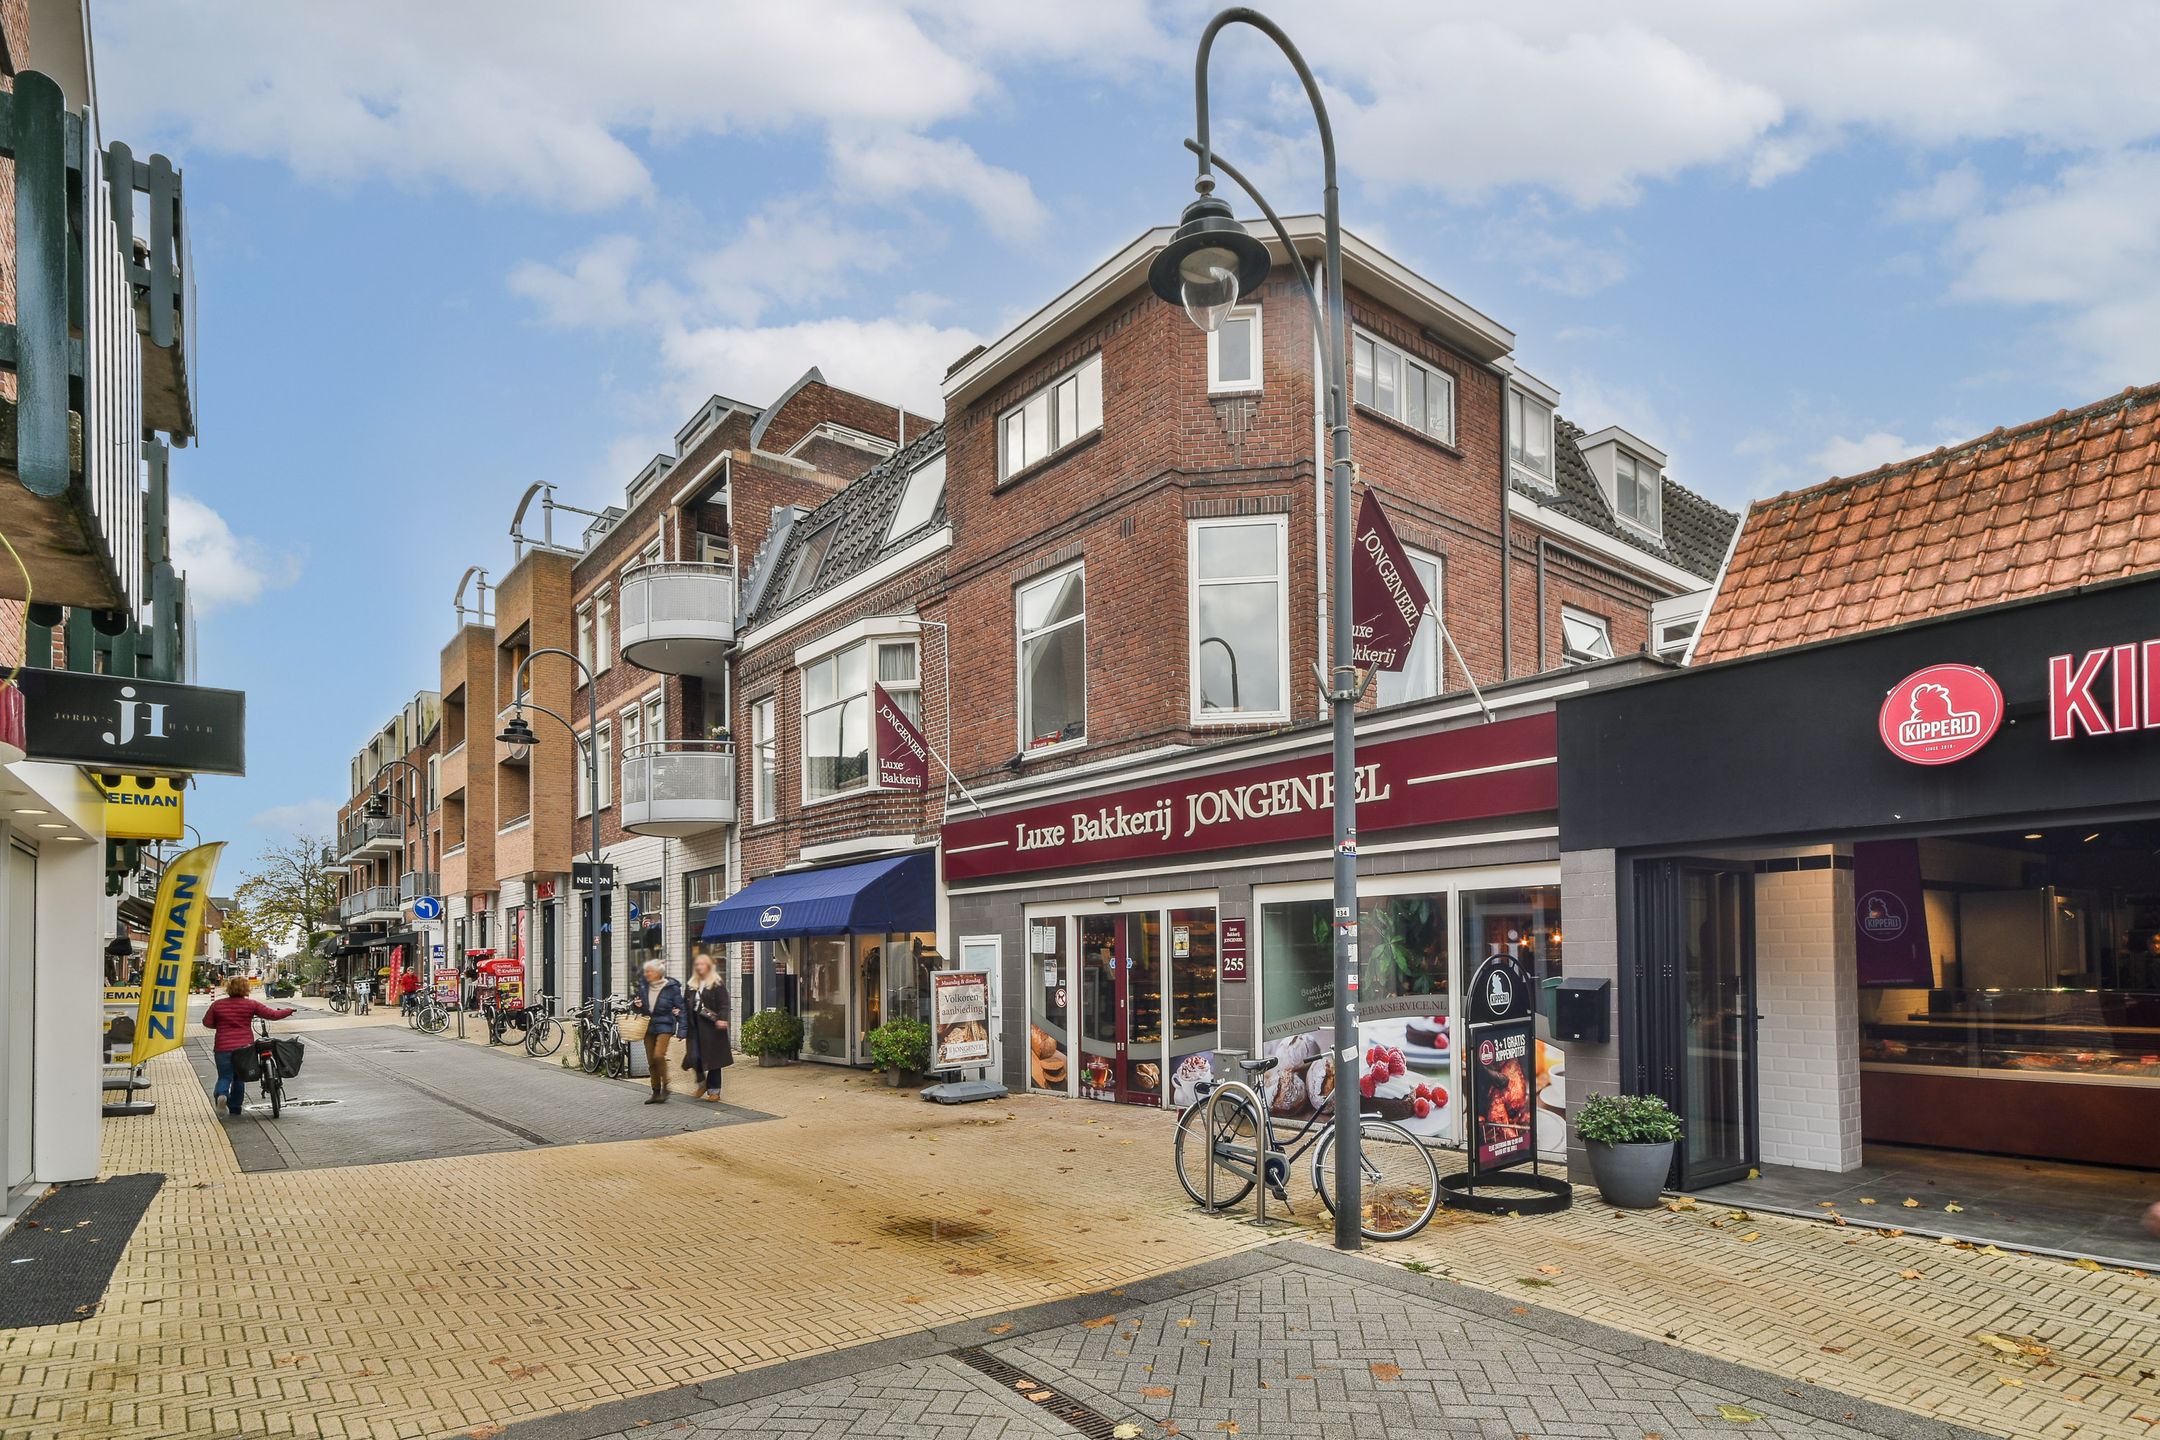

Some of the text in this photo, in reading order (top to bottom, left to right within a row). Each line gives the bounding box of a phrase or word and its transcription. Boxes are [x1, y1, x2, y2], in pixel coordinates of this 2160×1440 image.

[1358, 527, 1420, 627] JONGENEEL
[1352, 624, 1374, 638] uxe
[1352, 644, 1397, 668] kkerij
[53, 712, 213, 734] JORDY'S HAIR
[1905, 716, 1973, 741] KIPPERIJ
[876, 703, 927, 763] JONGENEEL
[880, 758, 904, 770] Luxe
[881, 772, 922, 788] Bakkerij
[108, 792, 178, 807] EEMAN
[1016, 823, 1065, 852] Luxe
[1071, 799, 1172, 844] Bakkerij
[576, 876, 611, 884] NELN
[1867, 918, 1898, 928] KIPPERIJ
[148, 874, 199, 1040] ZEEMAN
[1223, 957, 1244, 971] 255
[944, 993, 979, 1003] Volkoren
[941, 1005, 984, 1016] aanbieding
[1266, 1001, 1448, 1035] WWW.JONGENEEBAKSERVICE.NL
[1494, 1040, 1499, 1051] 3
[1506, 1034, 1526, 1049] GRATIS
[1495, 1045, 1526, 1062] KIPPENPOTEN
